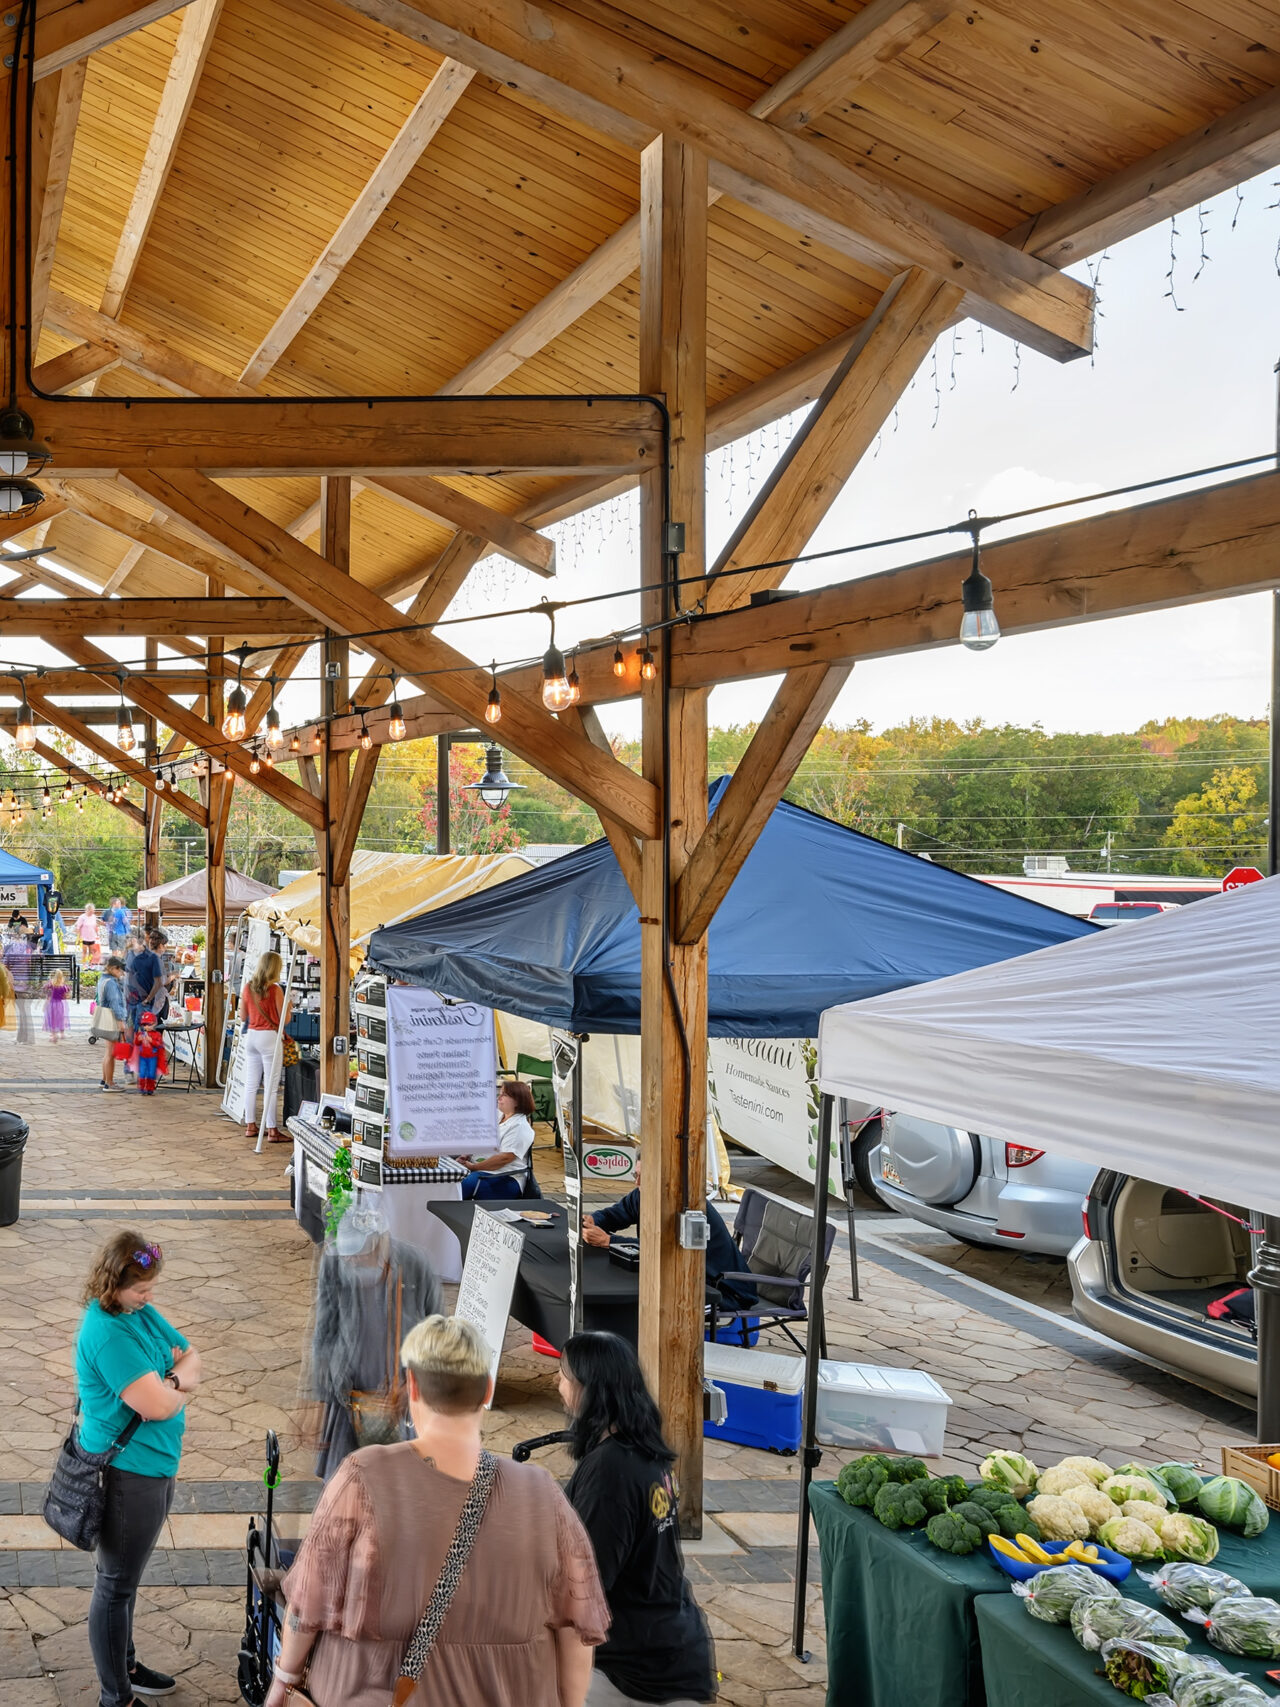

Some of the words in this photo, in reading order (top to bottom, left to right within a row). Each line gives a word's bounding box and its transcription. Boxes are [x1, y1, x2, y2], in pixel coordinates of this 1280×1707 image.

[765, 1080, 791, 1098] Sauces
[729, 1088, 784, 1123] Tastenini.com
[598, 1154, 629, 1169] apples
